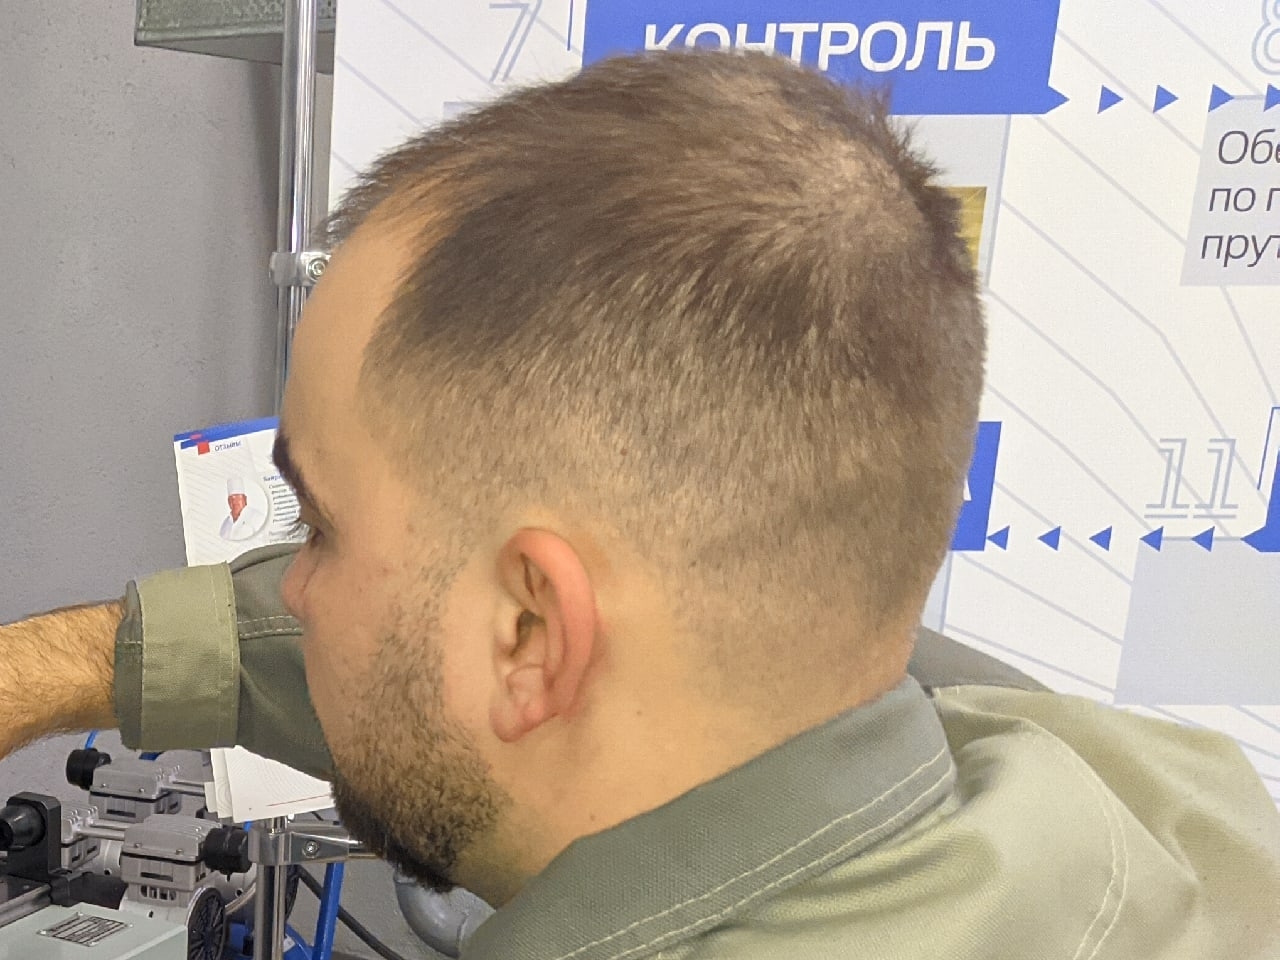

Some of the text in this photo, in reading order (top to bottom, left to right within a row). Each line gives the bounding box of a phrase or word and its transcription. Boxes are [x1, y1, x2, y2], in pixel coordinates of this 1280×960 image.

[643, 20, 996, 73] КОНТРОЛЬ
[1208, 186, 1257, 213] по
[1144, 438, 1239, 519] 11
